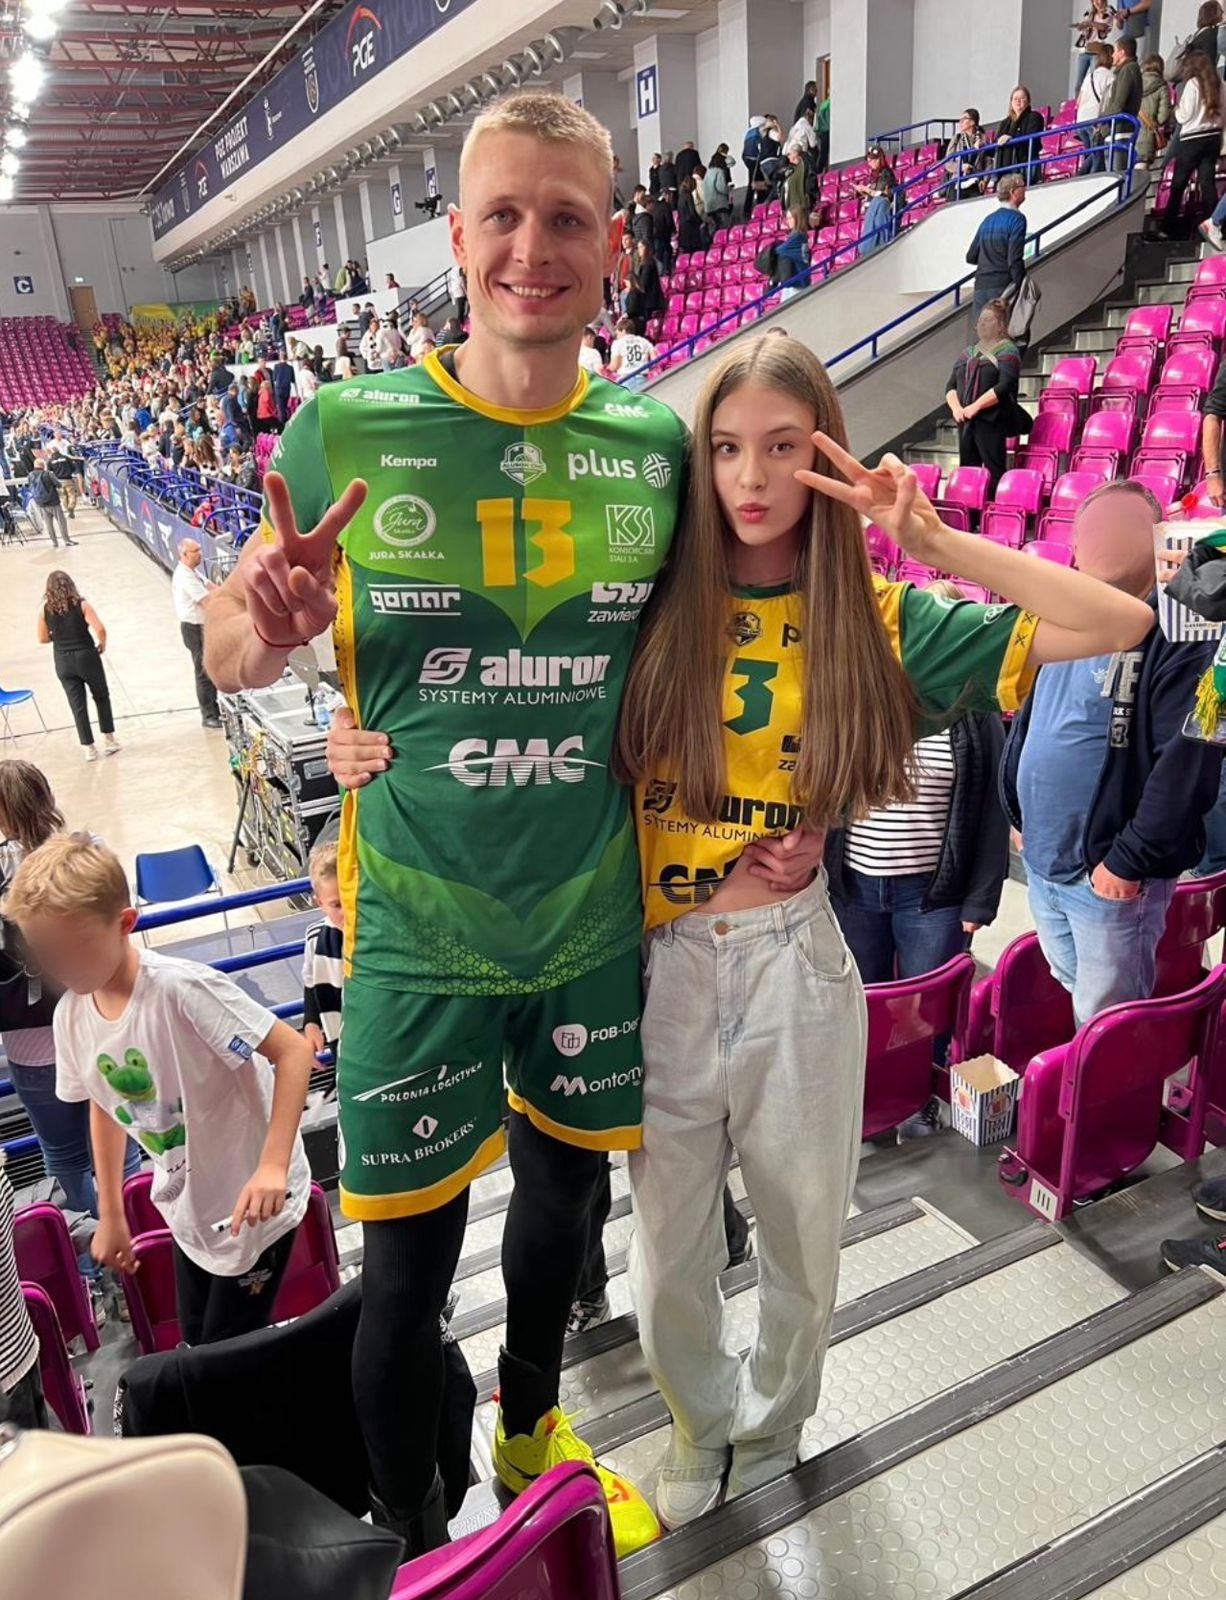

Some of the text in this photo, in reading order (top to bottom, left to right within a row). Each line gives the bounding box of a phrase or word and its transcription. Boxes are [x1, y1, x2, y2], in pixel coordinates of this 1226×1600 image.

[352, 30, 375, 77] PGE
[640, 75, 655, 115] H
[17, 279, 30, 293] C
[626, 344, 642, 362] 36
[363, 389, 420, 404] aluron
[380, 454, 437, 470] Kempa
[567, 449, 637, 480] plus
[368, 550, 445, 560] JURA SKAŁKA
[476, 497, 575, 588] 13
[479, 648, 611, 687] aluron
[418, 686, 607, 705] SYSTEMY ALUMINIOWE
[447, 735, 586, 787] CMC
[718, 796, 805, 831] uron
[380, 1061, 483, 1103] POLONIA LOGISTYKA
[361, 1121, 475, 1166] SUPRA BROKERS
